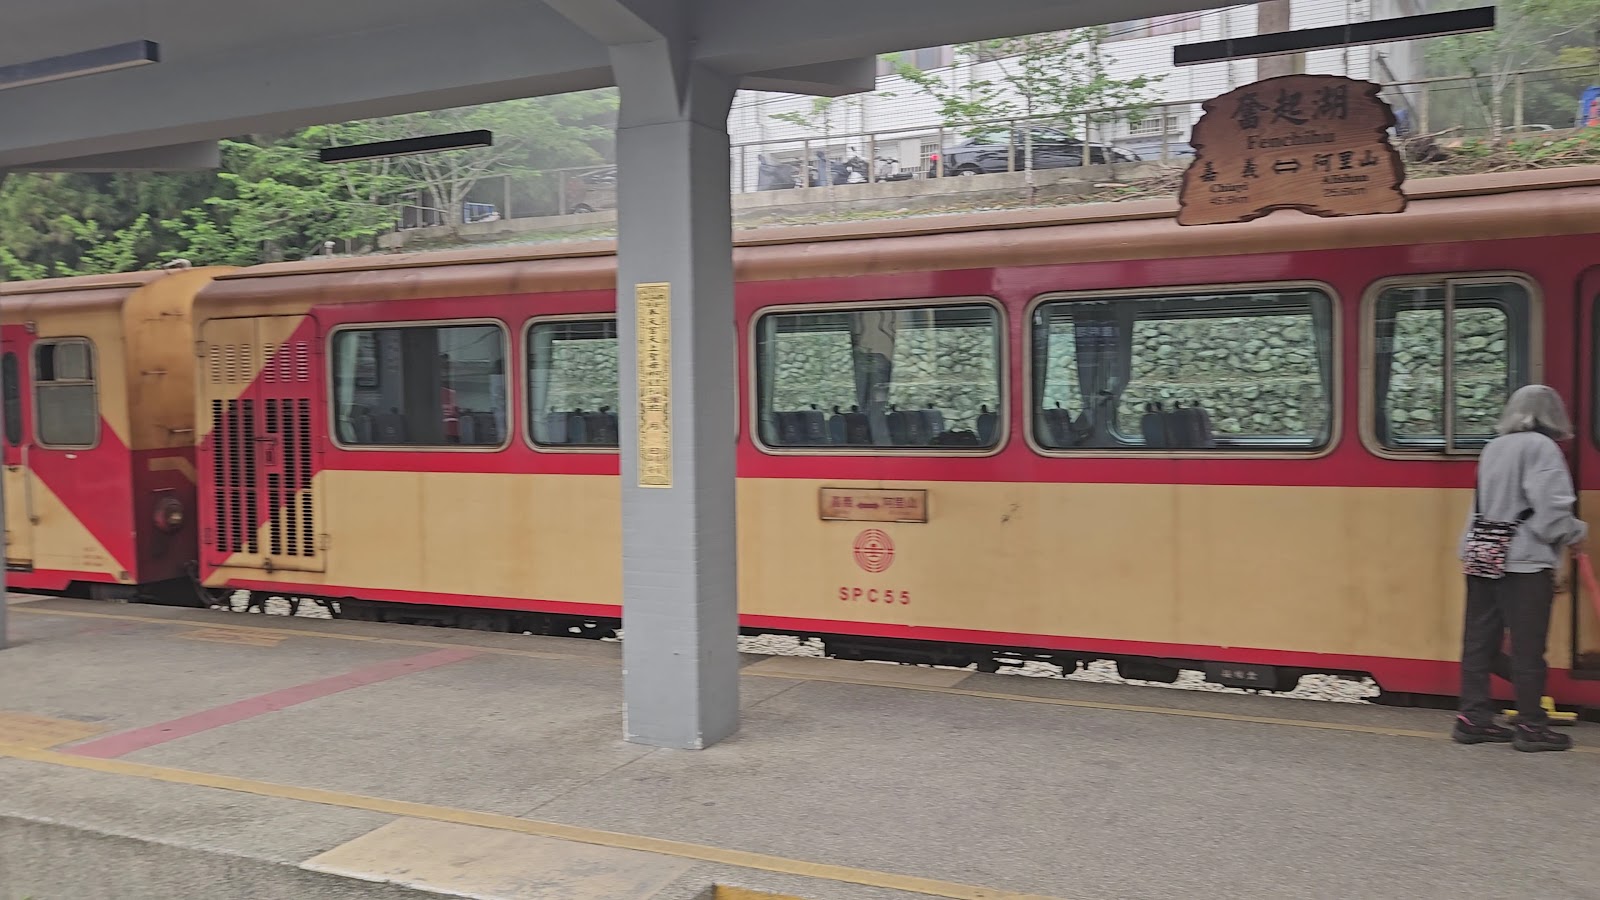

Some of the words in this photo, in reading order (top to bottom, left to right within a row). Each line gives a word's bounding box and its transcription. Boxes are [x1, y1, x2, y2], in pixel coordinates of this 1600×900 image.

[1231, 85, 1349, 130] 奮起湖
[1200, 158, 1259, 182] 嘉義
[1312, 149, 1378, 172] 阿里山
[839, 586, 911, 605] SPC55
